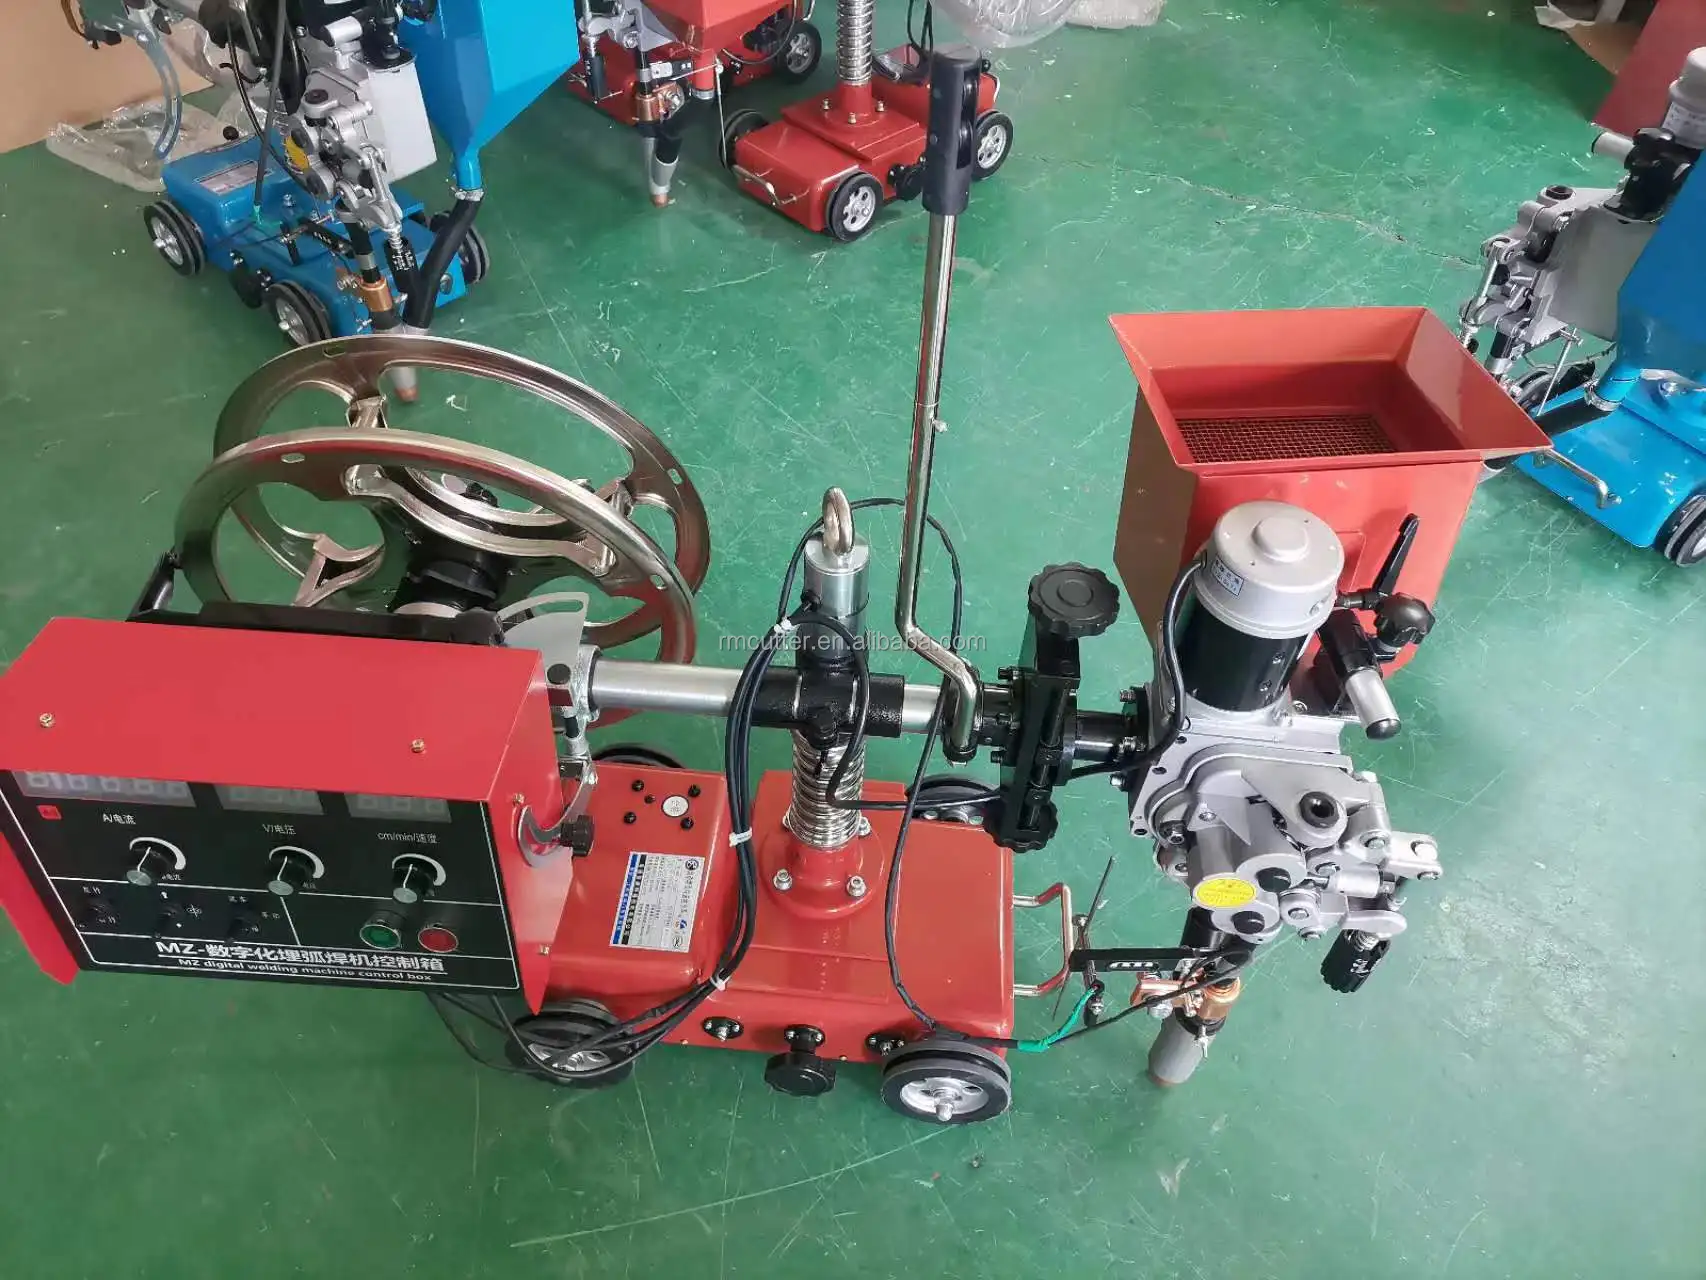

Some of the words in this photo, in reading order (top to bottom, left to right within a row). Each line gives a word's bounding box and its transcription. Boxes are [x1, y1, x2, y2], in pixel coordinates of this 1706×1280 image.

[155, 941, 445, 972] MZ-数字化埋弧焊机控制箱
[178, 958, 201, 967] MZ
[203, 960, 245, 970] digital
[247, 963, 299, 974] welding
[301, 966, 355, 977] machine
[357, 970, 404, 980] control
[406, 972, 432, 981] box
